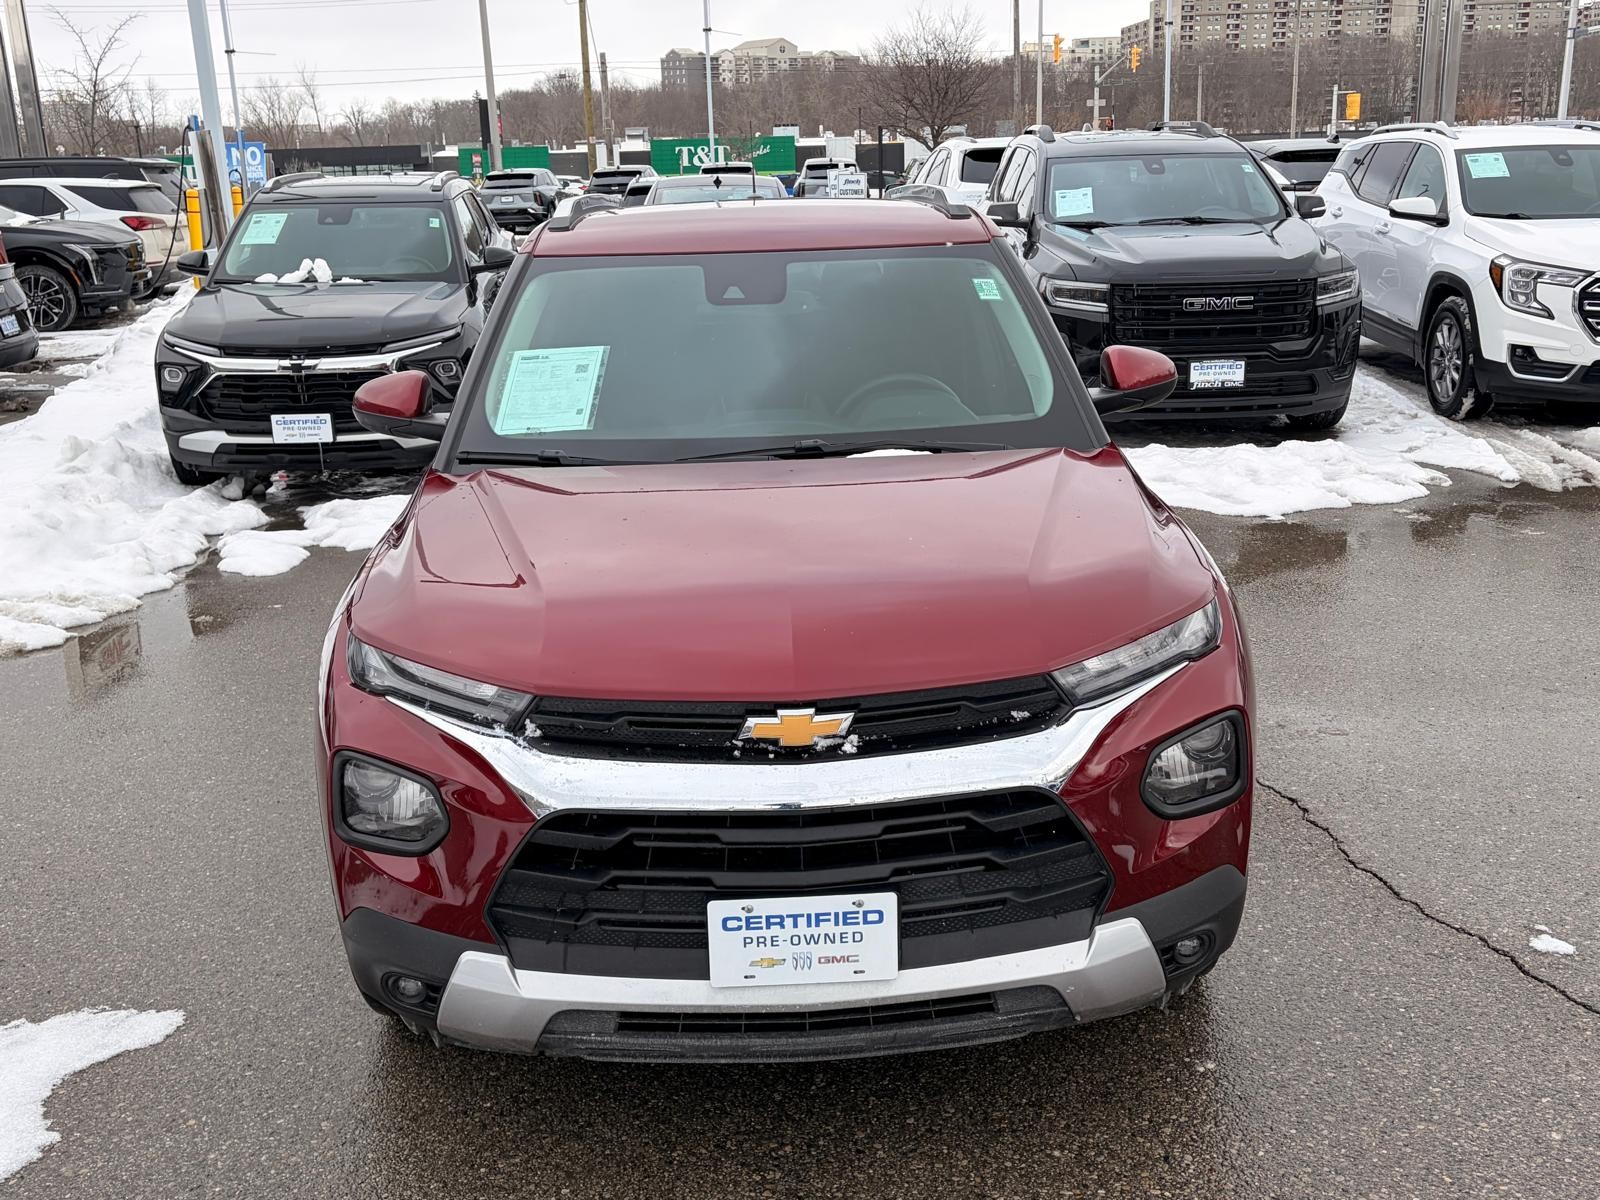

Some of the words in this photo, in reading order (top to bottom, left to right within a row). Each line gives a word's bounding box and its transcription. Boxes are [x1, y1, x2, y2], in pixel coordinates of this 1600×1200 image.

[230, 146, 261, 166] NO
[675, 145, 730, 167] T&T
[839, 188, 864, 196] CUSTOMER
[1183, 296, 1254, 312] GMC
[1193, 363, 1243, 371] CERTIFIED
[1190, 380, 1221, 391] finch
[721, 909, 885, 932] CERTIFIED
[743, 931, 864, 949] PRE-OWNED
[817, 954, 860, 965] GMC
